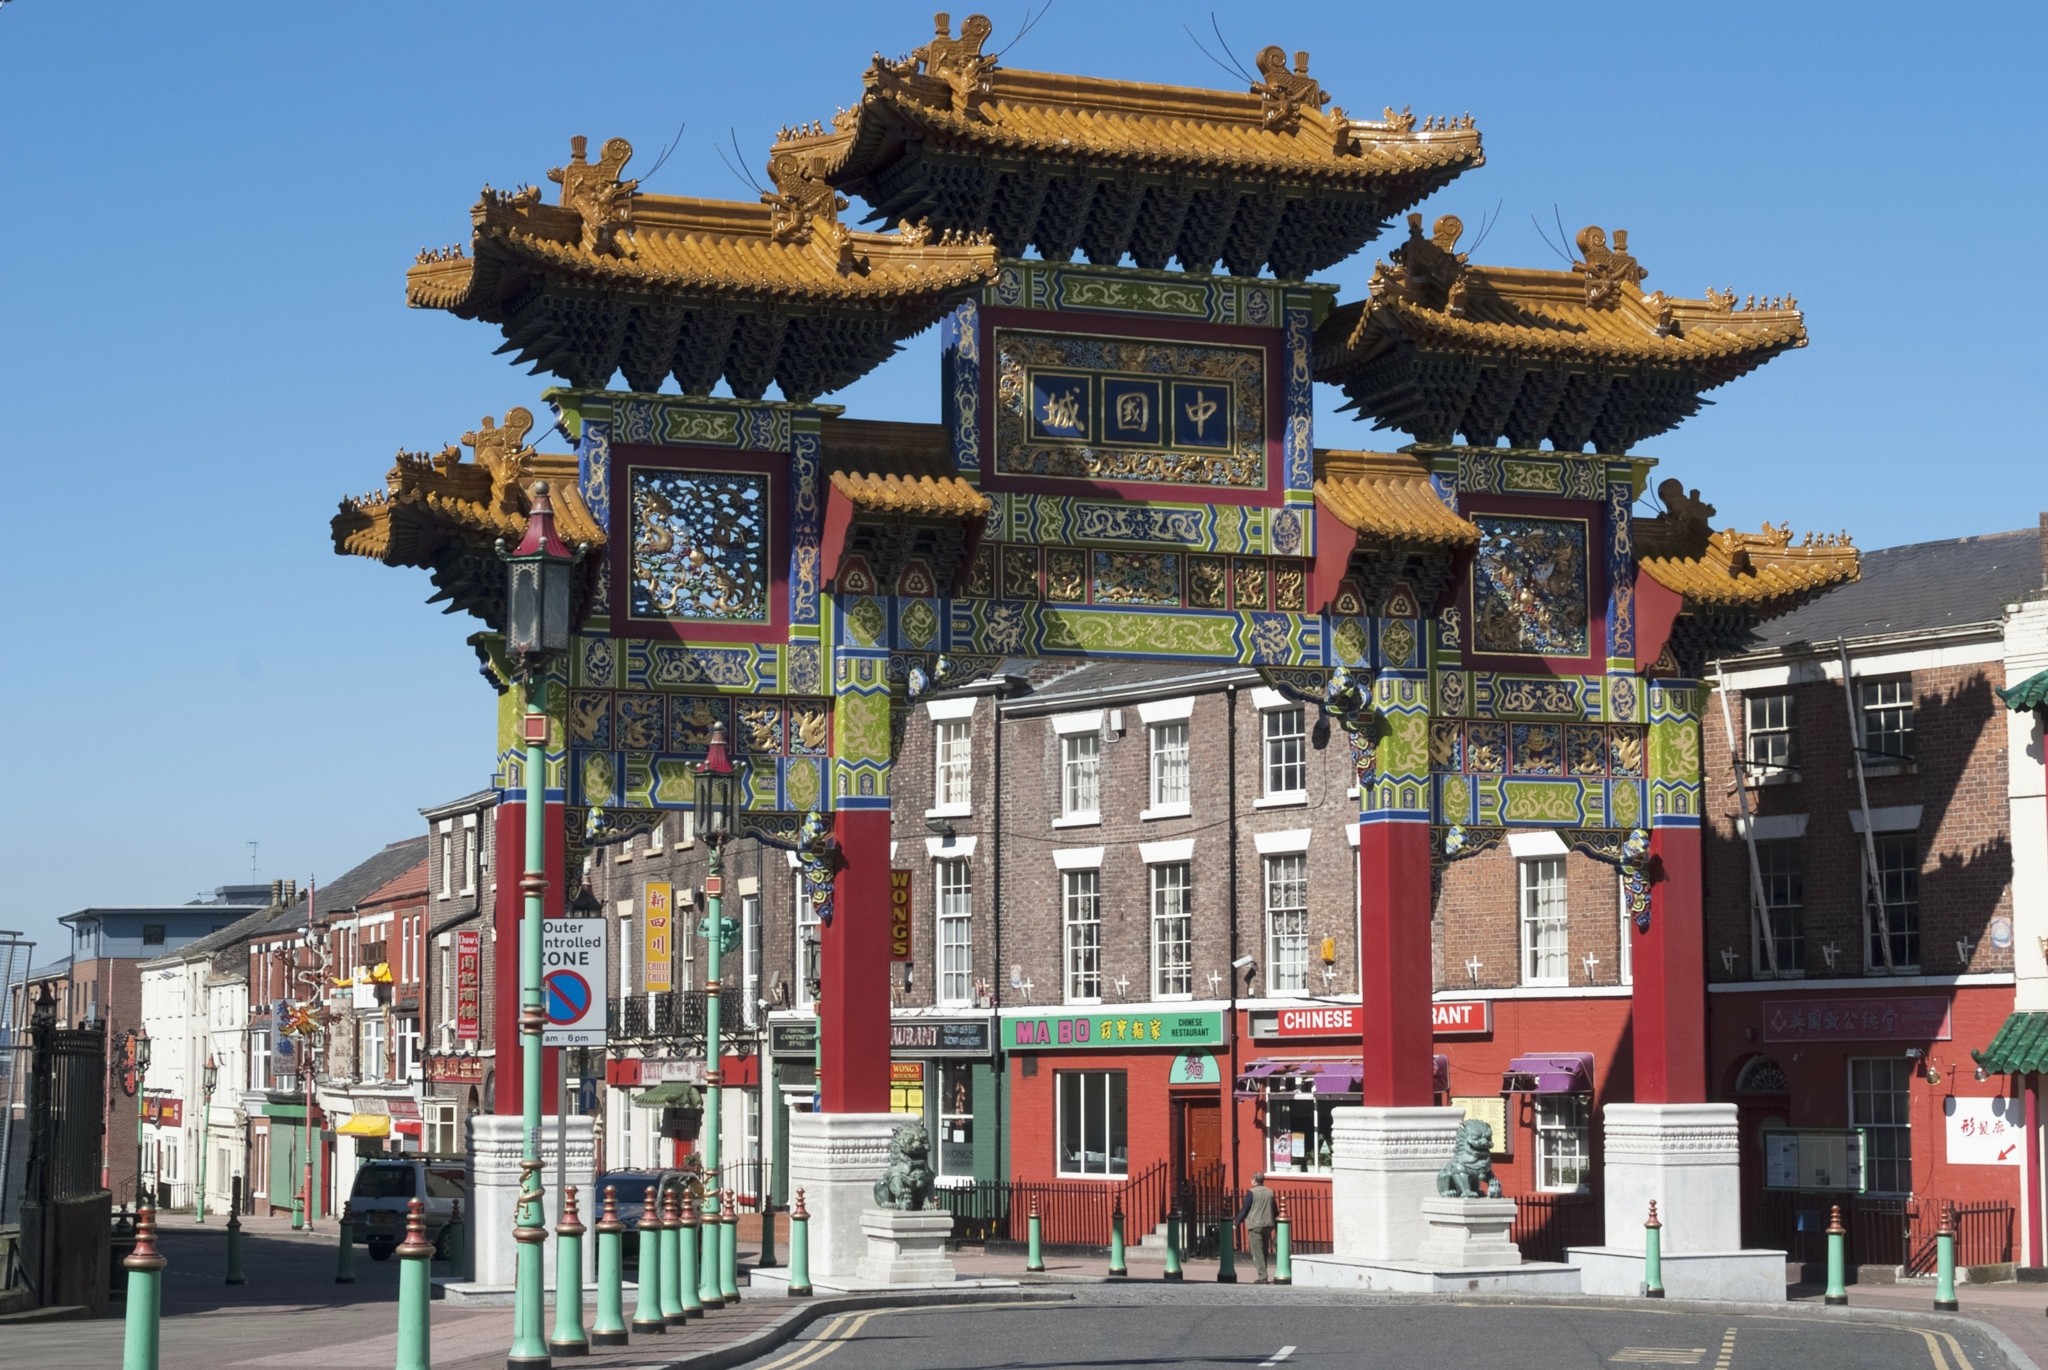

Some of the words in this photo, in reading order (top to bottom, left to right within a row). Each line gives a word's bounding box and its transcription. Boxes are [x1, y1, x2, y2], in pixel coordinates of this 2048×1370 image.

[891, 872, 909, 955] WONGS
[543, 921, 583, 933] Outer
[650, 890, 667, 956] 新四川
[545, 936, 601, 948] ntrolled
[647, 962, 669, 972] CHILLI
[647, 973, 669, 983] CHILLI
[1178, 1018, 1203, 1027] CHINESE
[1284, 1010, 1353, 1030] CHINESE
[890, 1026, 939, 1046] AURANT
[1015, 1020, 1051, 1044] MA
[1057, 1018, 1090, 1044] BO
[1171, 1027, 1210, 1037] RESTAURANT
